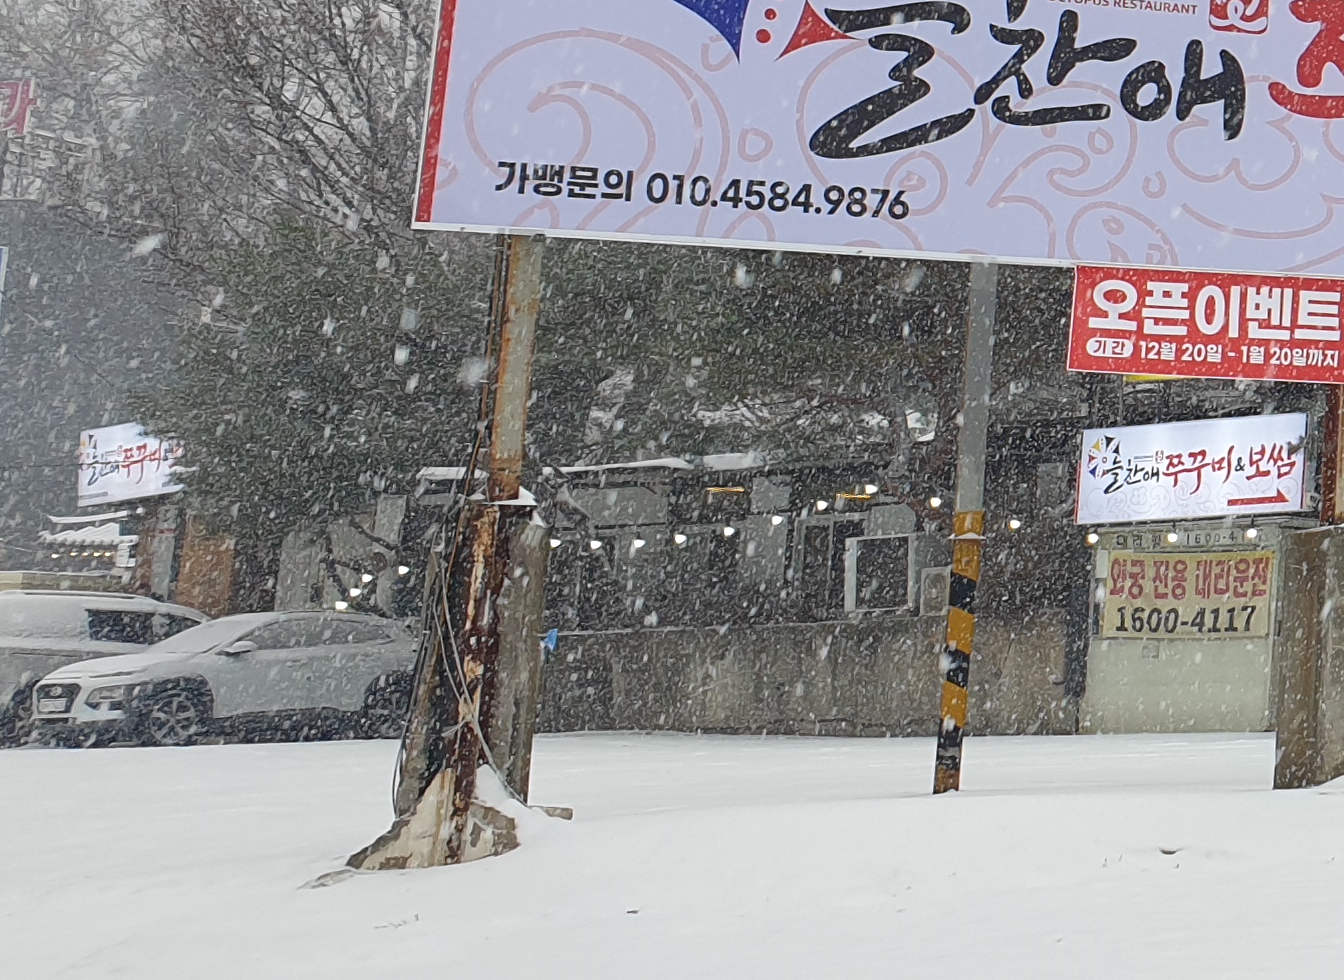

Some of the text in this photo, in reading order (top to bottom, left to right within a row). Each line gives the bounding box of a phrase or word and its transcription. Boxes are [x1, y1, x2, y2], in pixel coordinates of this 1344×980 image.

[494, 160, 910, 220] 가맹문의 010.4584.9876
[1088, 279, 1342, 341] 오픈이벤트
[1093, 339, 1127, 356] 기간
[1139, 341, 1177, 361] 12월
[1181, 343, 1223, 362] 20일
[1240, 345, 1265, 365] 1월
[1269, 347, 1339, 368] 20일까지
[1103, 455, 1160, 496] 늘찬애
[1109, 556, 1271, 601] 와궁 전용 대리운전
[1115, 605, 1257, 634] 1600-4117
